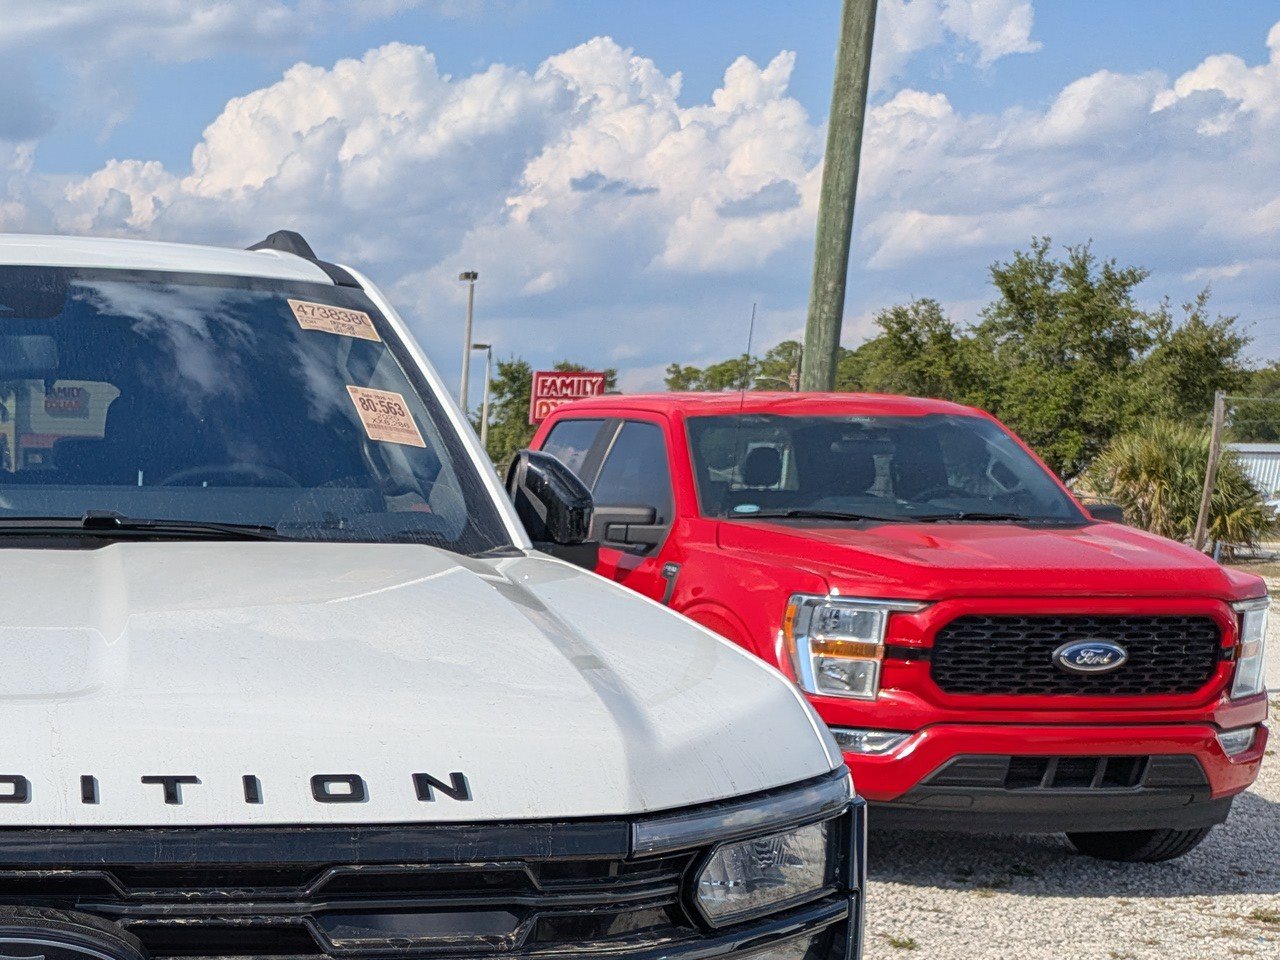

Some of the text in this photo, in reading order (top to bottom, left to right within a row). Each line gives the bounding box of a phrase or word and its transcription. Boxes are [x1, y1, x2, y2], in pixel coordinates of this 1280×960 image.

[537, 376, 603, 397] FAMILY
[359, 397, 405, 417] 80:563
[1076, 649, 1112, 664] Ford
